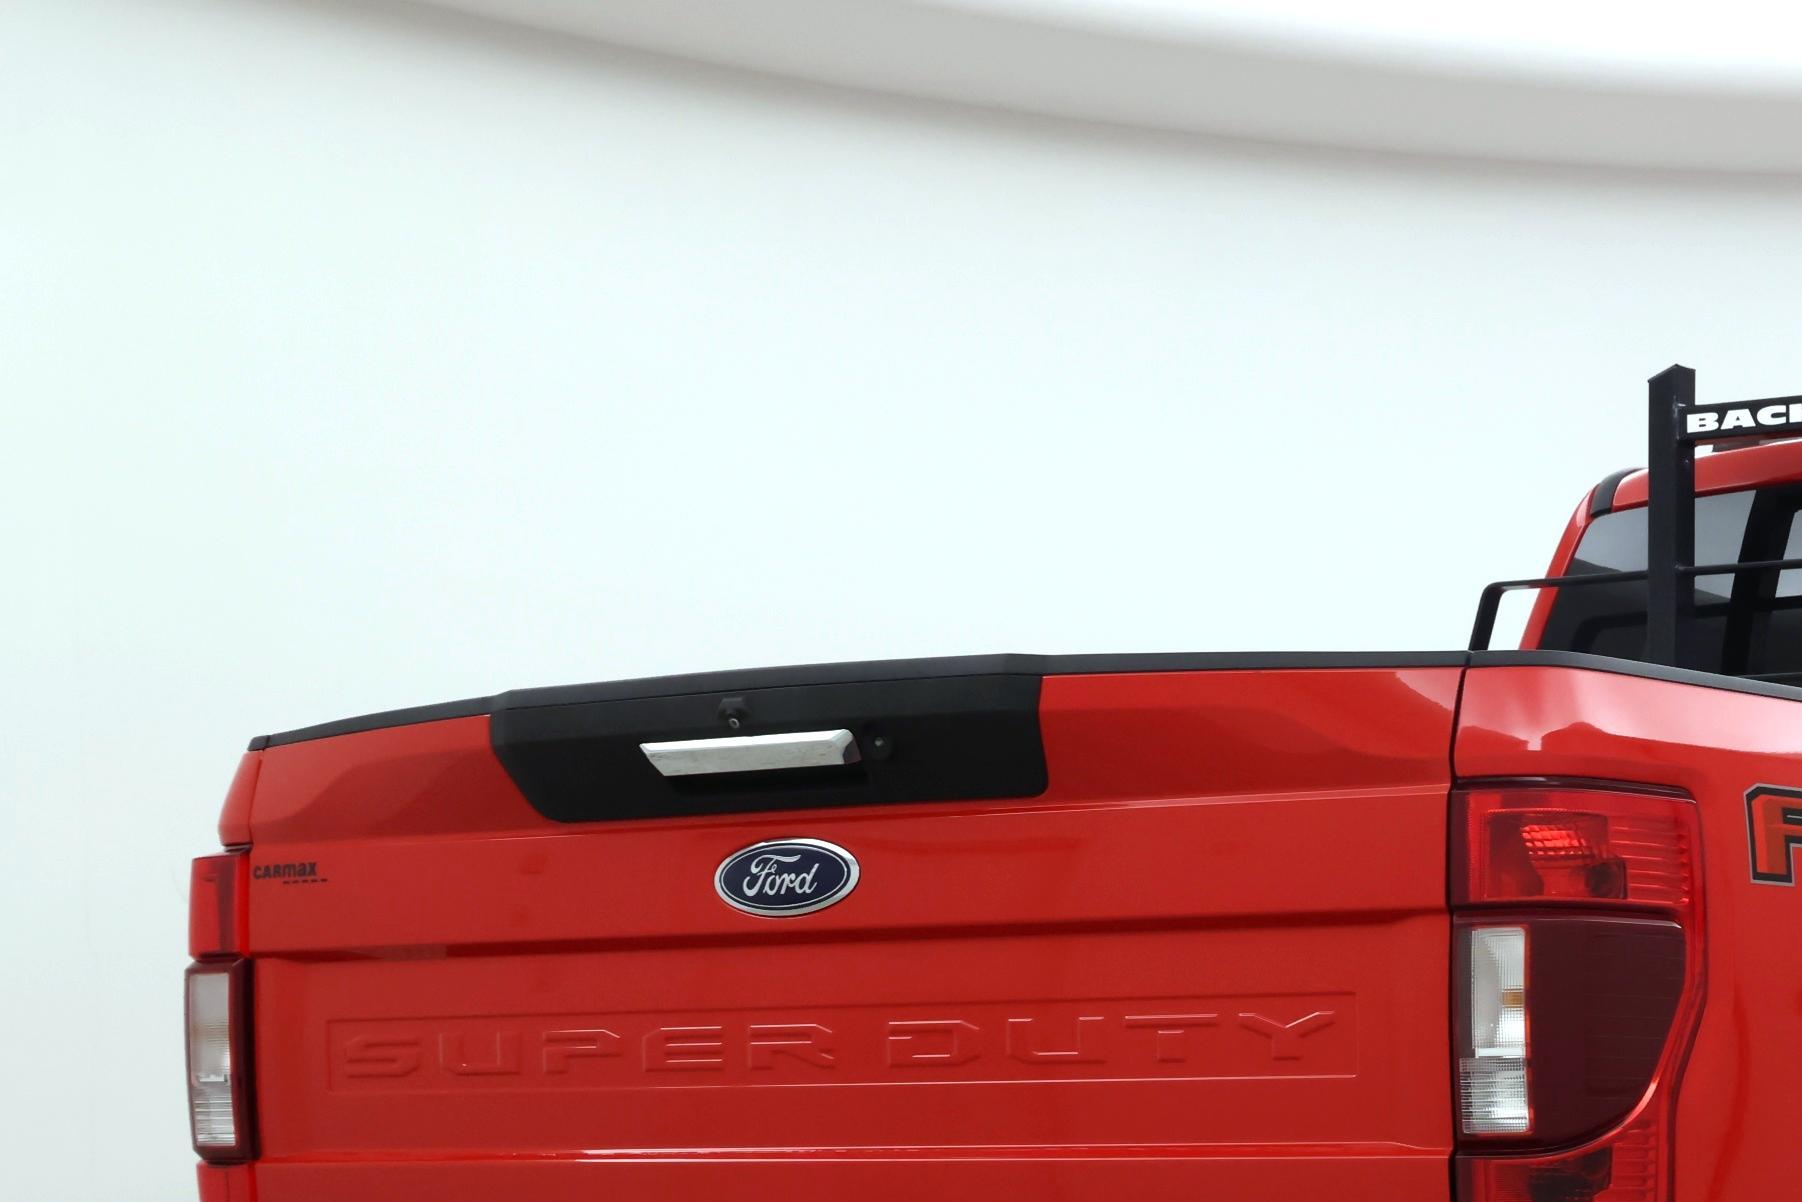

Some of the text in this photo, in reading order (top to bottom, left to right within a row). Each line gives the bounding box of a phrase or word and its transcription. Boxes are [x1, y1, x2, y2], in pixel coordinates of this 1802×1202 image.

[743, 854, 819, 896] Ford
[346, 1010, 1335, 1079] SUPER DUTY
